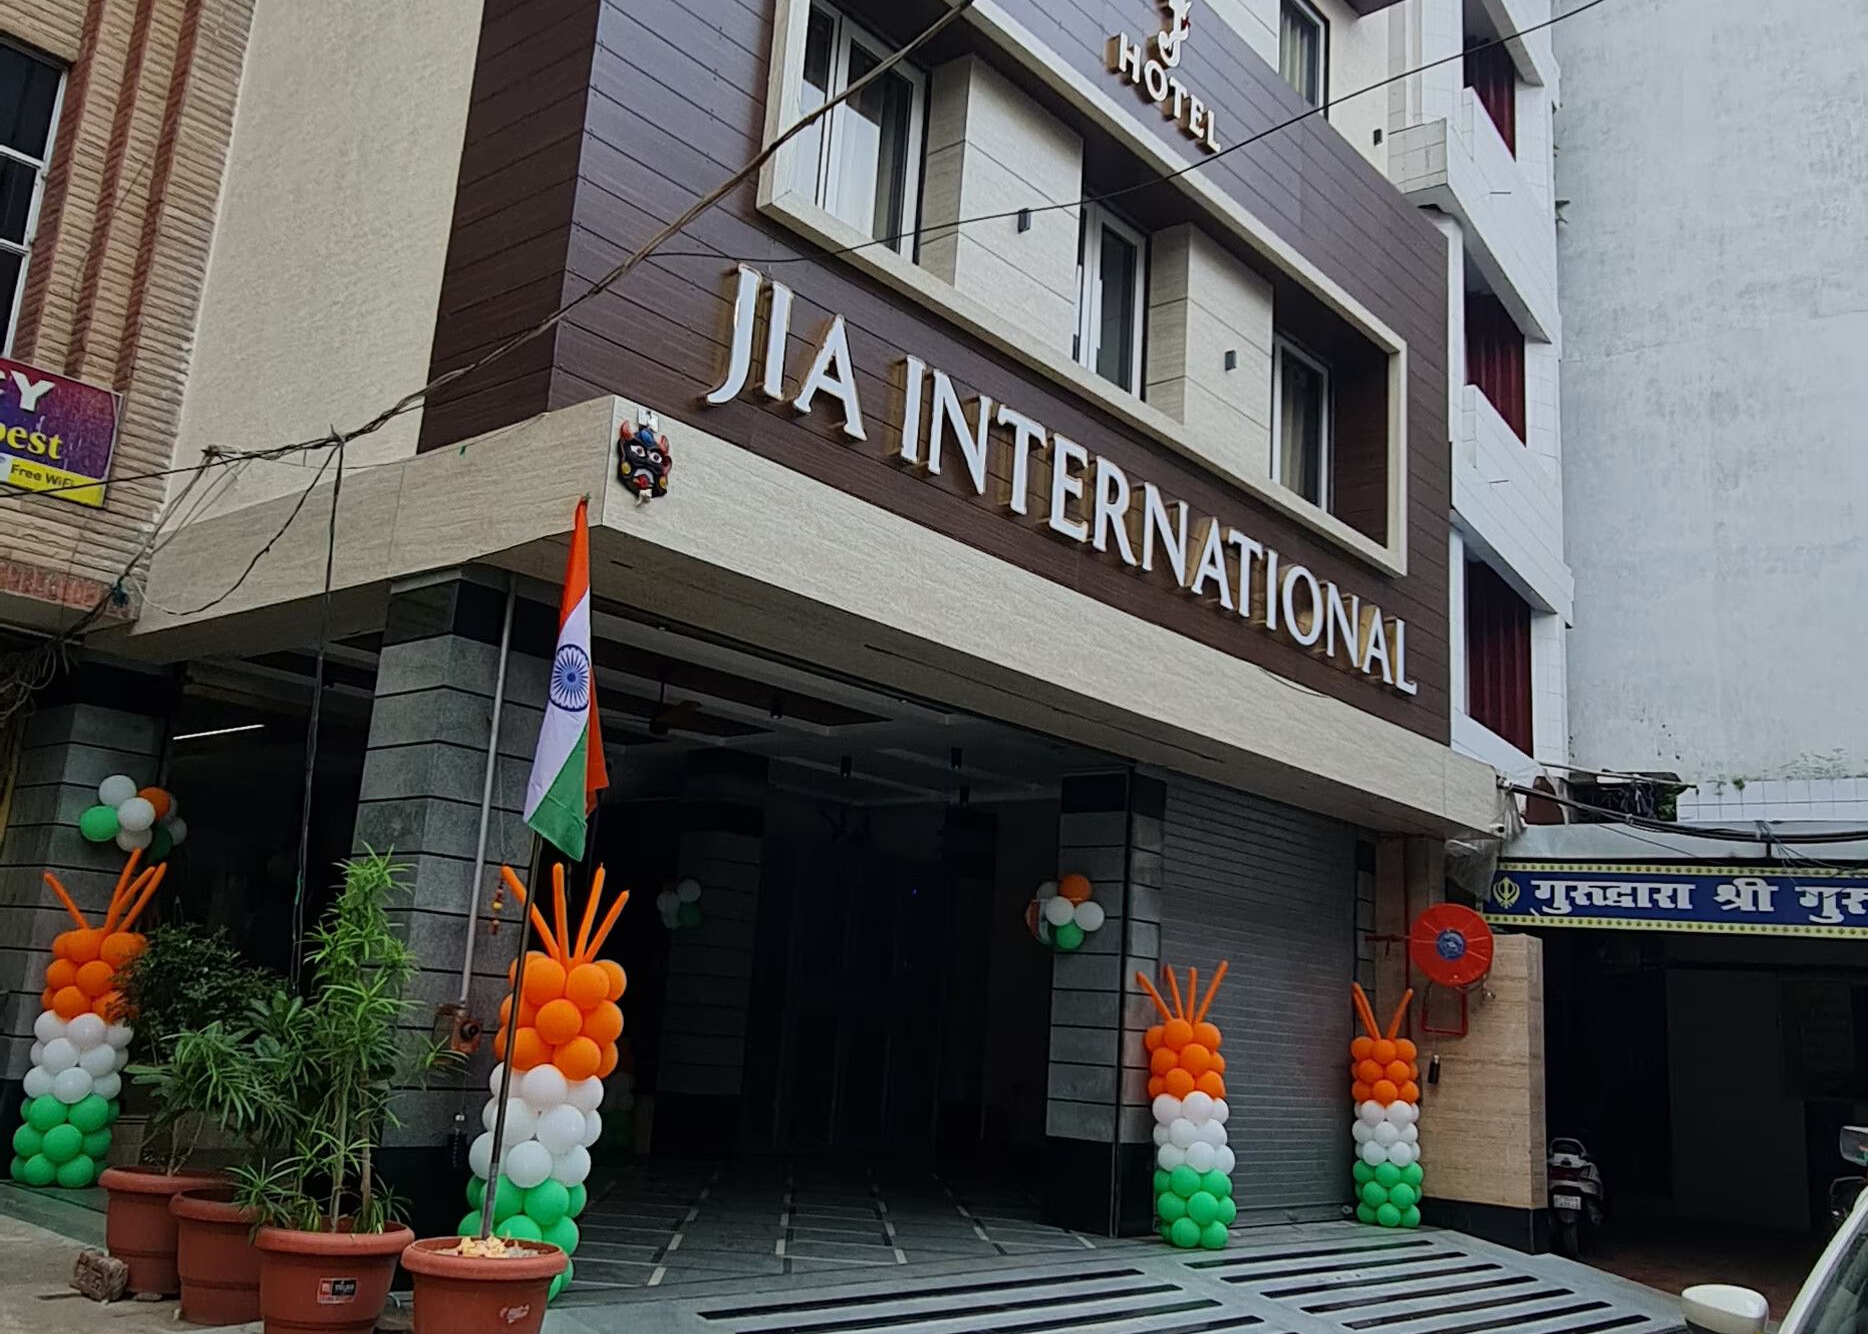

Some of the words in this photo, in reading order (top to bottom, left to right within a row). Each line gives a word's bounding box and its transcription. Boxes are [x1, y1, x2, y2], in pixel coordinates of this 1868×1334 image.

[1118, 31, 1221, 154] HOTEL
[0, 369, 56, 412] Y
[11, 463, 42, 482] Free
[706, 262, 868, 442] JIA
[901, 353, 1418, 696] INTERNATIONAL
[1713, 877, 1779, 912] श्री
